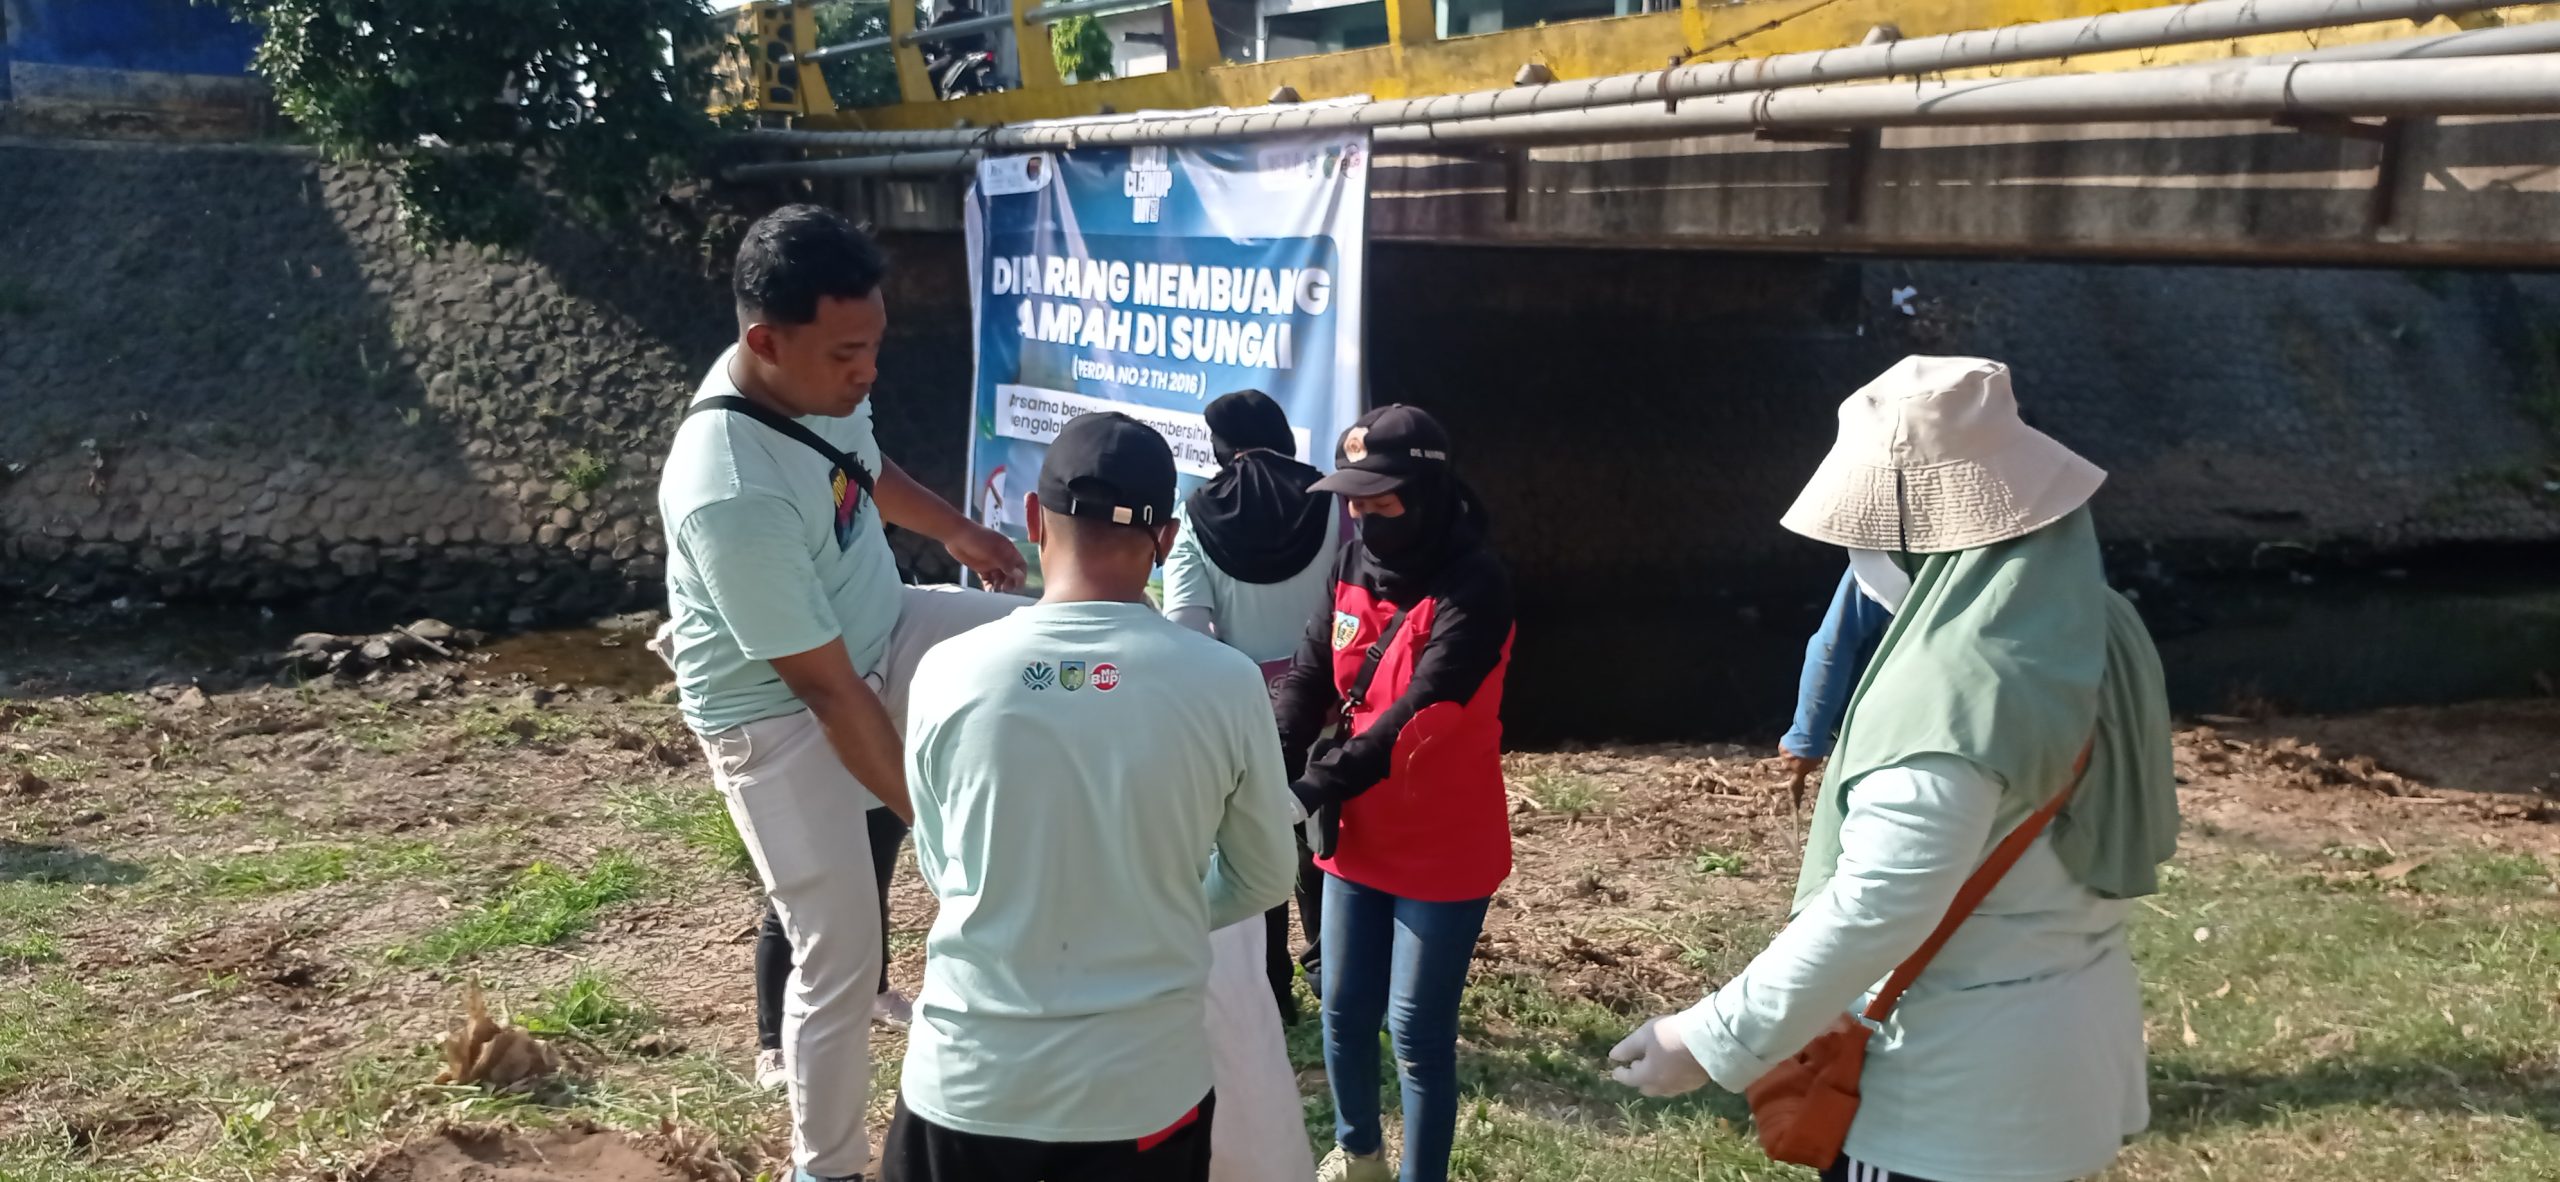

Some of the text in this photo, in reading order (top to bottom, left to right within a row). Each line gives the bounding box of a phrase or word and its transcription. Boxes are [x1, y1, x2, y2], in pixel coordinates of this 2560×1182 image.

[1133, 262, 1331, 316] MEMBUANG
[1135, 311, 1167, 358] DI
[1171, 315, 1293, 370] SUNGAI
[1118, 365, 1139, 386] NO
[1140, 367, 1150, 388] 2
[1150, 369, 1168, 391] TH
